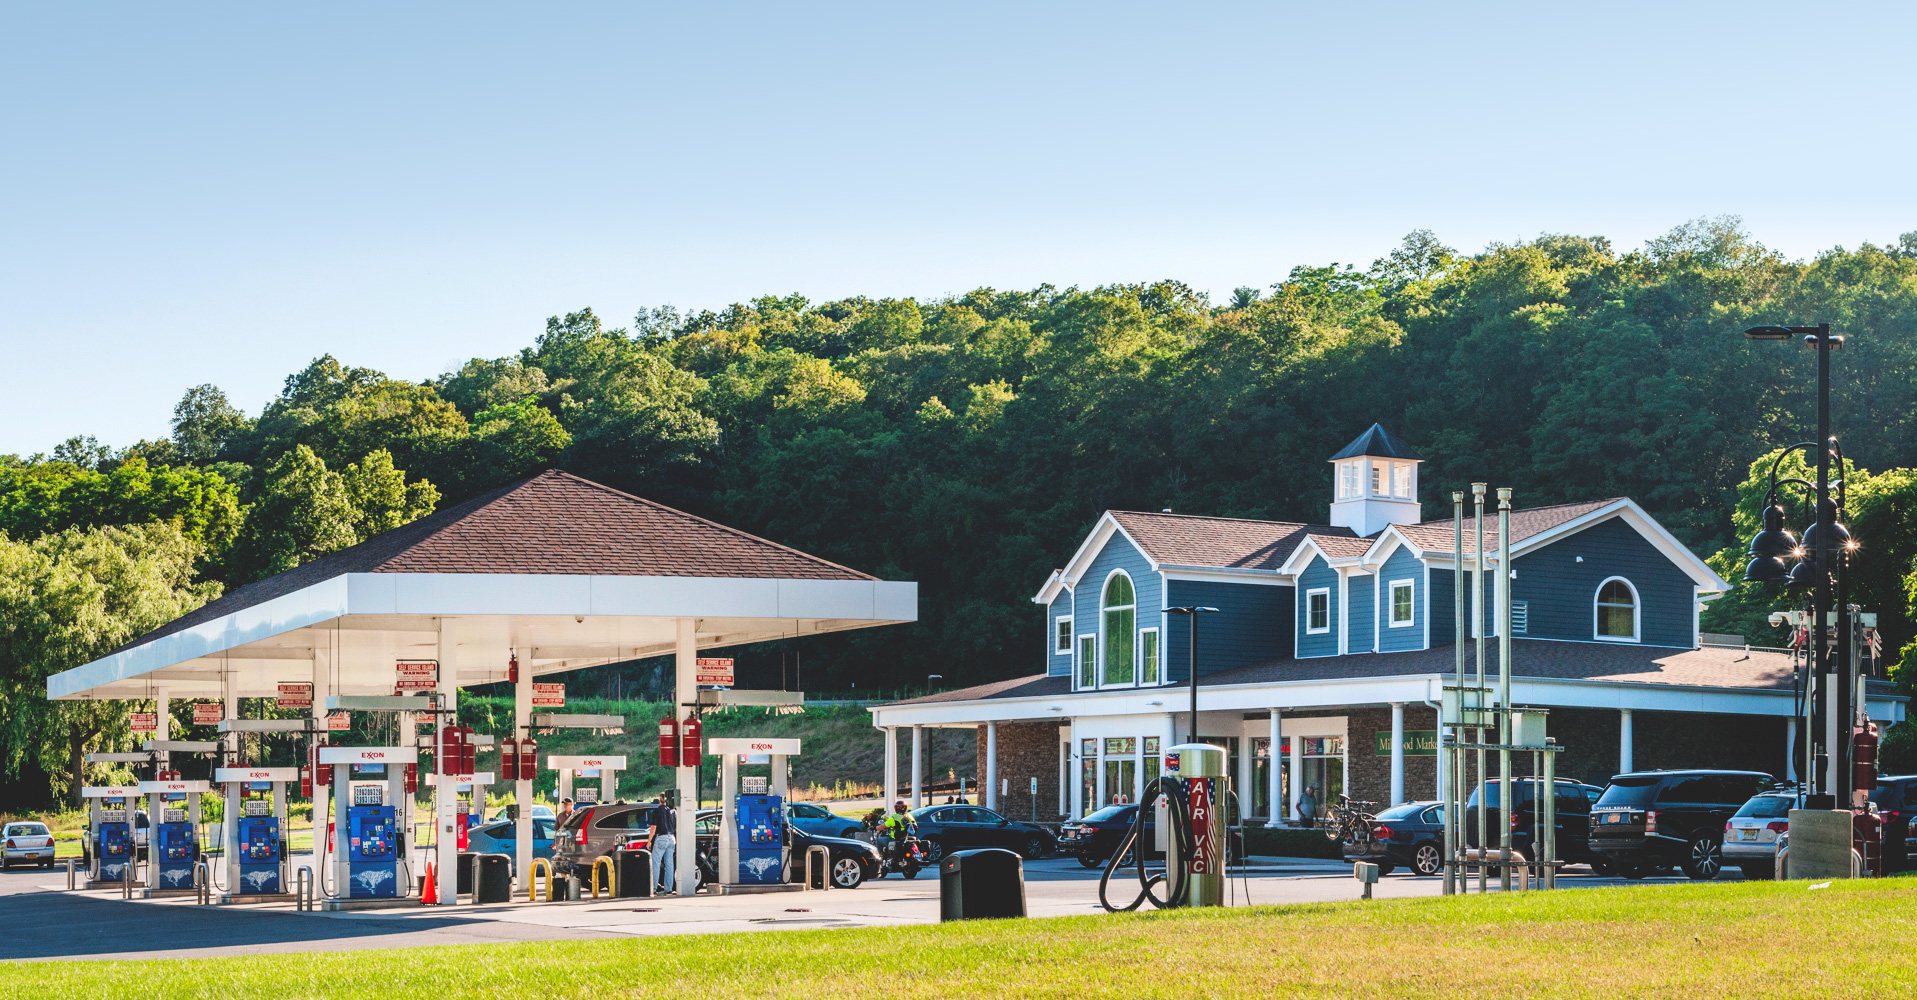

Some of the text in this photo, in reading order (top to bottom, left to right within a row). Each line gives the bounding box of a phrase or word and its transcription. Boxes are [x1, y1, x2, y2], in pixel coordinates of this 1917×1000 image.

[751, 743, 773, 752] EXXON
[1379, 736, 1438, 750] Milod Marke
[361, 752, 385, 760] EXXON
[395, 808, 403, 817] 16
[1192, 781, 1205, 873] AIR VAC
